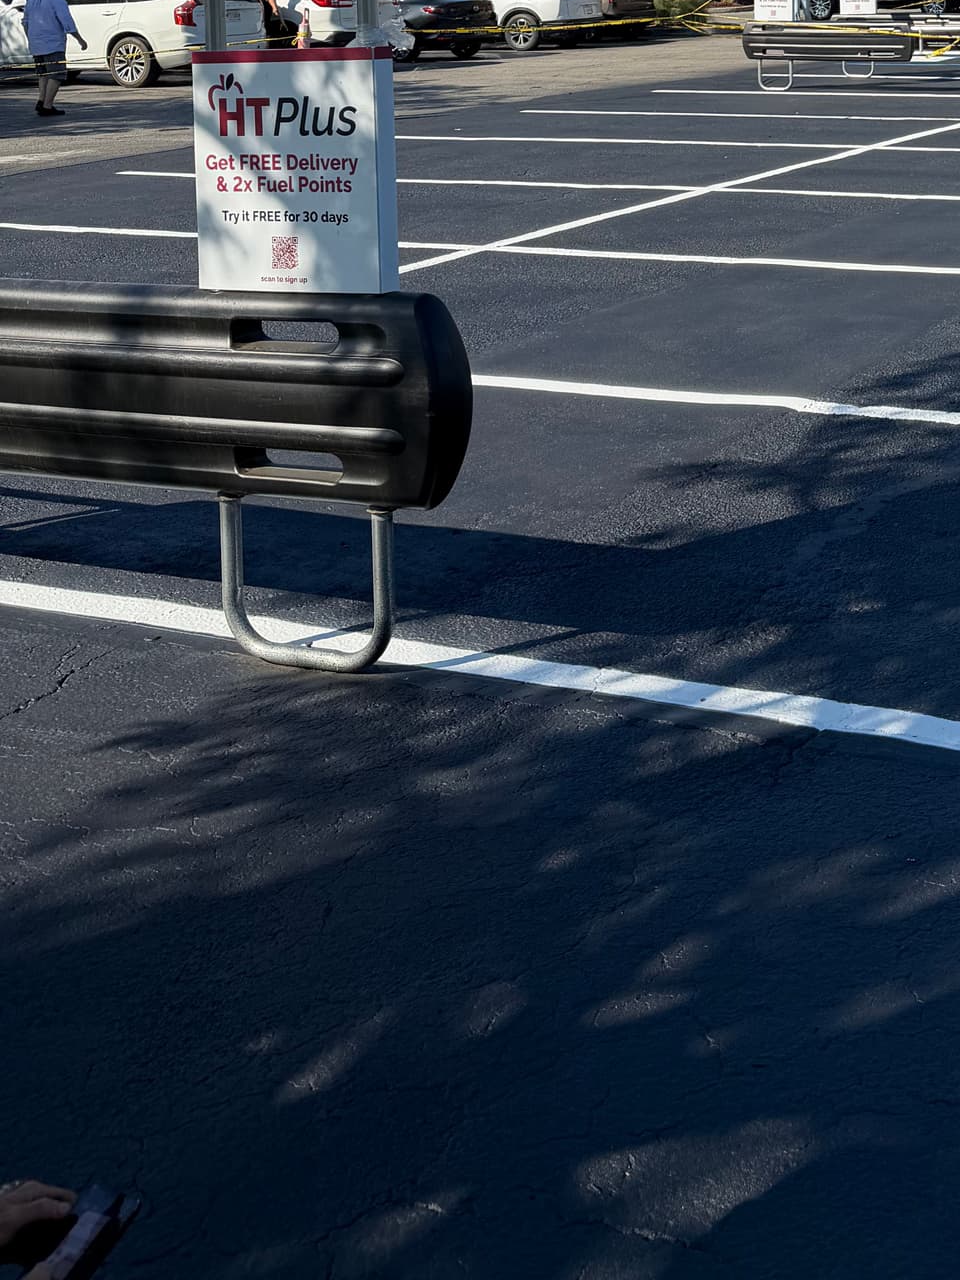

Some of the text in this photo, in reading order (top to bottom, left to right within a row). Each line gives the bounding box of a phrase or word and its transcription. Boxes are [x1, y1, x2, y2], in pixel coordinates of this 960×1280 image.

[218, 95, 357, 137] HT Plus
[206, 153, 358, 175] Get FREE Delivery
[216, 175, 352, 193] & 2x Fuel Points
[222, 210, 349, 225] Try it FREE for 30 days
[285, 275, 298, 284] sign
